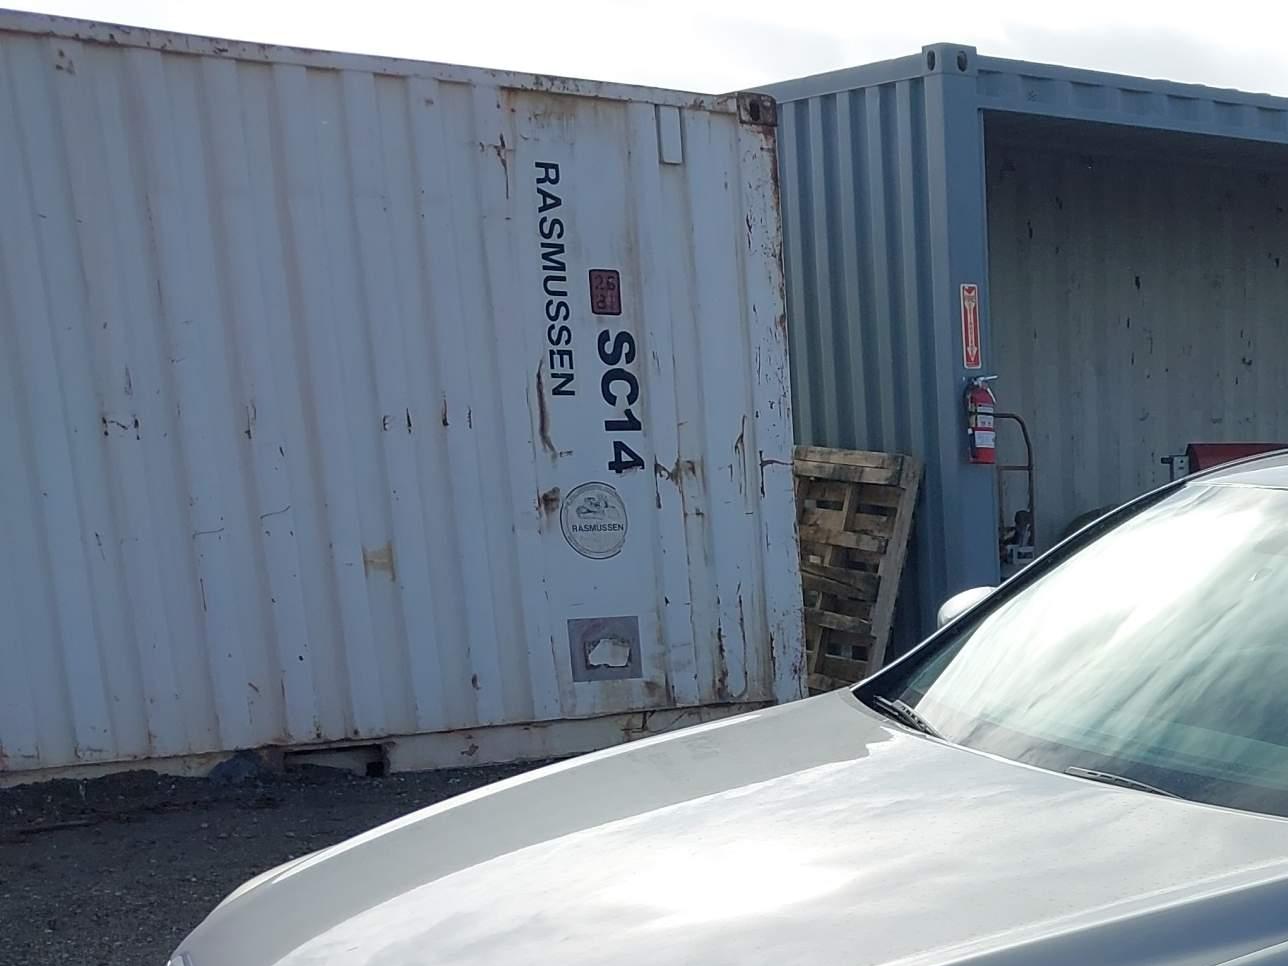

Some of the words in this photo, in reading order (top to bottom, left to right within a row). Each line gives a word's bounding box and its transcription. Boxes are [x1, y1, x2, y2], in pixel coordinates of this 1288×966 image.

[534, 161, 576, 397] RASMUSSEN
[597, 329, 645, 474] SC14
[571, 523, 624, 533] RASMUSSEN
